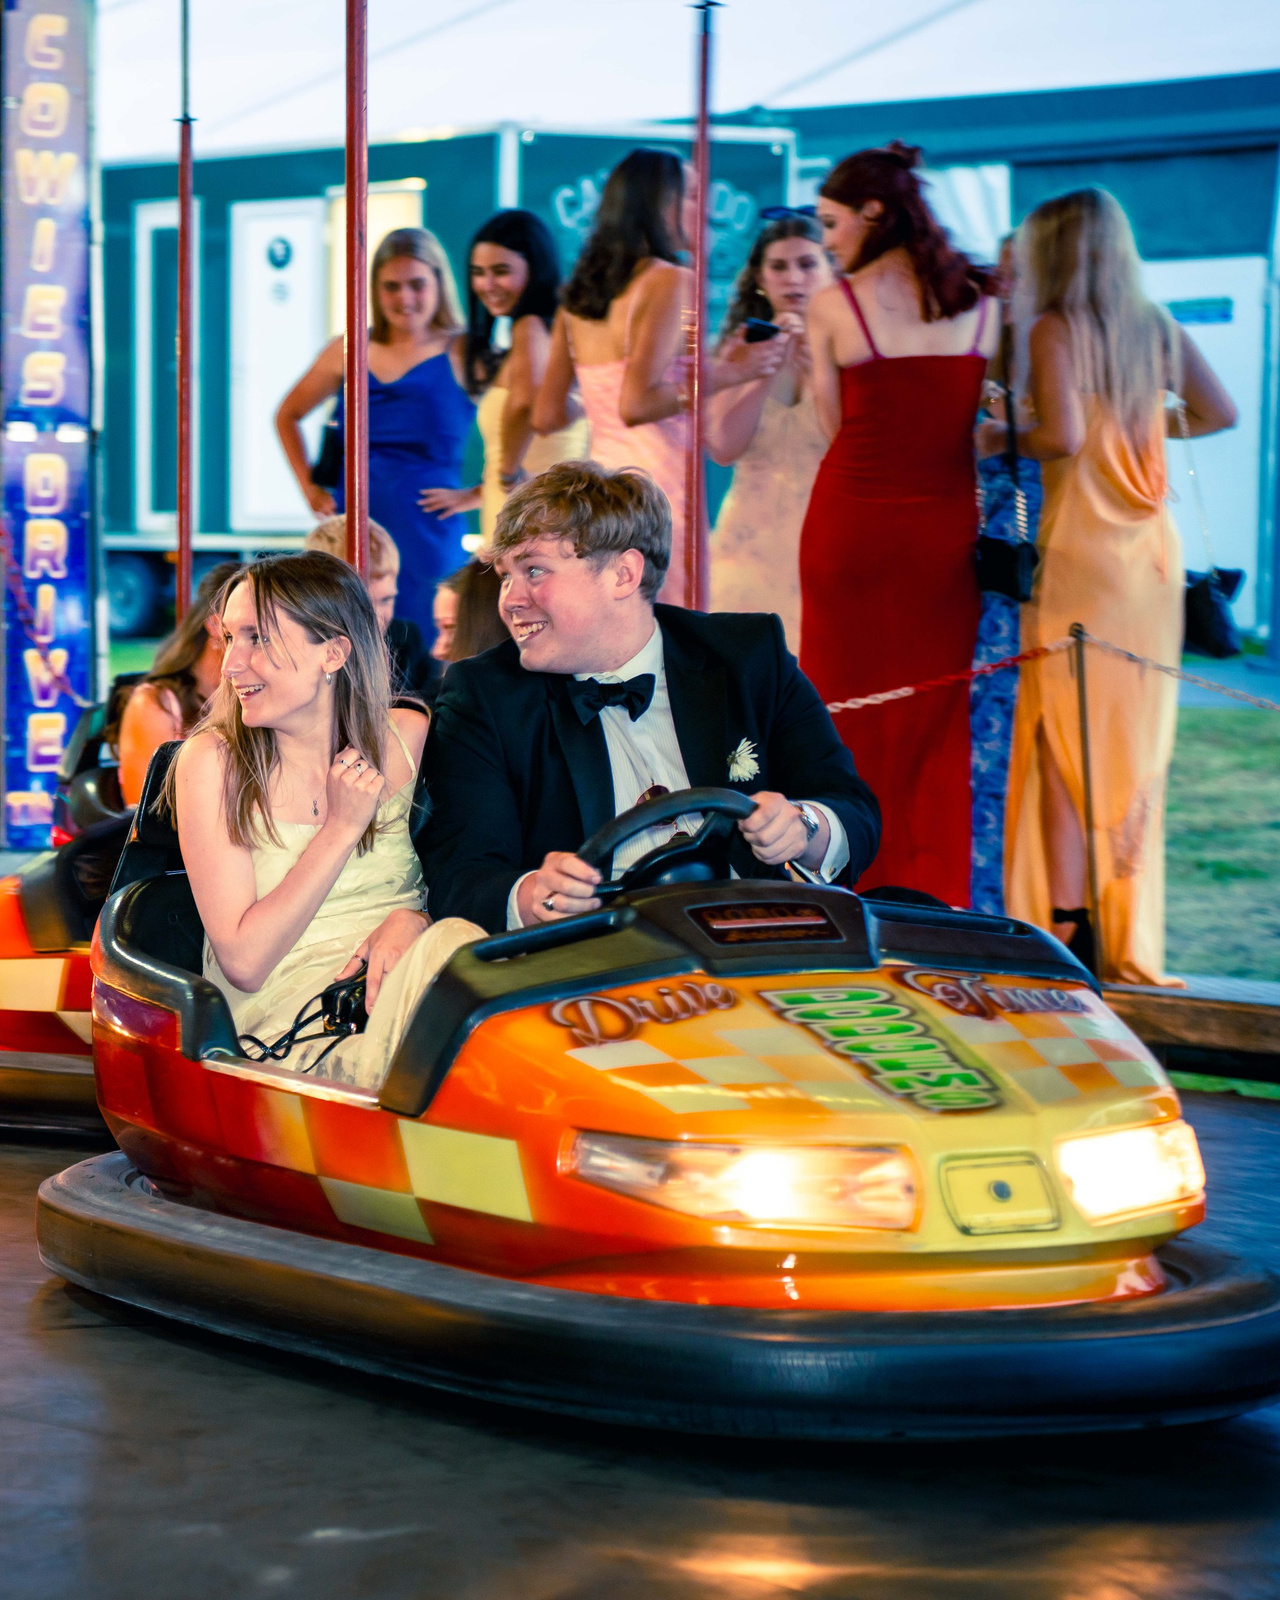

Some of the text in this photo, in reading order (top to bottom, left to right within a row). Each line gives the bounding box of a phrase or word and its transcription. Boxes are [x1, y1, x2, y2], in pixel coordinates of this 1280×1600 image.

[14, 14, 77, 406] COWIES
[23, 453, 68, 773] DRIVE
[551, 982, 735, 1047] Drive
[758, 986, 1000, 1110] DODGEMS
[903, 969, 1084, 1019] Time
